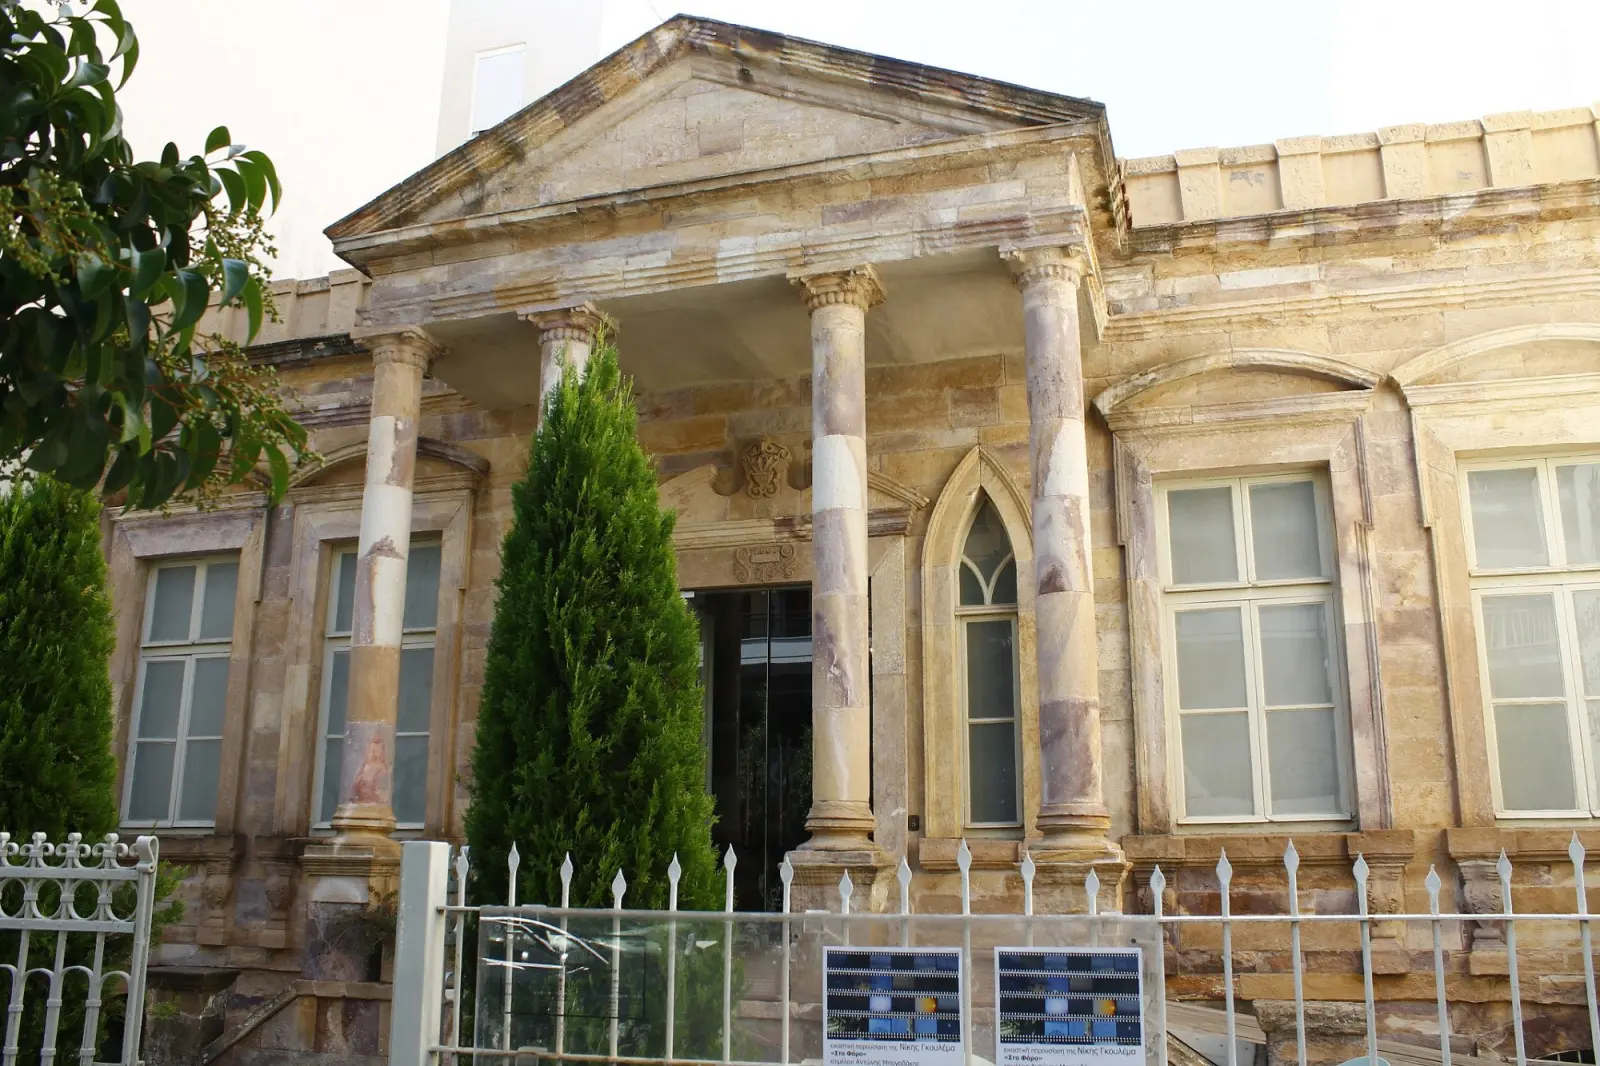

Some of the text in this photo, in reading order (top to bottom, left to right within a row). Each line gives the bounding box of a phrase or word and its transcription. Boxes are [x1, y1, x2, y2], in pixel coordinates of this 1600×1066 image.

[899, 1043, 919, 1052] Νίκης
[921, 1044, 956, 1053] Γκουλέμα
[1077, 1046, 1098, 1056] Νίκης
[1100, 1047, 1136, 1056] Γκουλέμα
